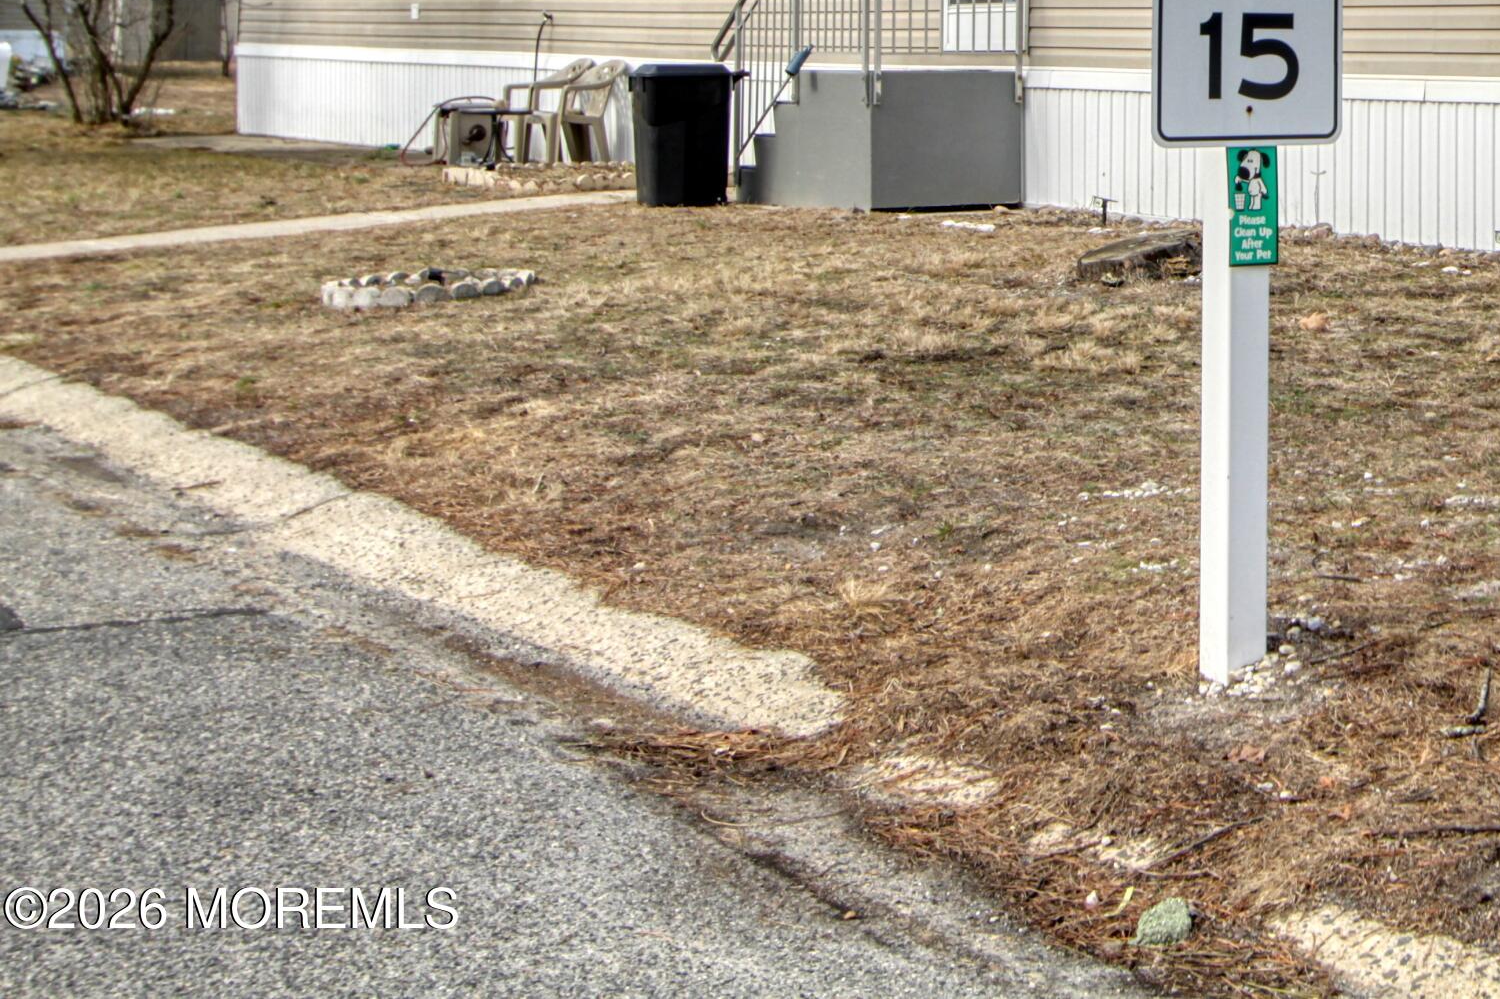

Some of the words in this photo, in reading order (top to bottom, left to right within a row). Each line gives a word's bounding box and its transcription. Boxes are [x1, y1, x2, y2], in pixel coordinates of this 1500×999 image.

[1199, 11, 1300, 101] 15
[1239, 215, 1266, 225] Please
[1234, 227, 1256, 238] Clean
[1259, 227, 1273, 239] Up
[1241, 238, 1264, 250] After
[1235, 250, 1254, 261] Your
[1256, 249, 1272, 260] Pet
